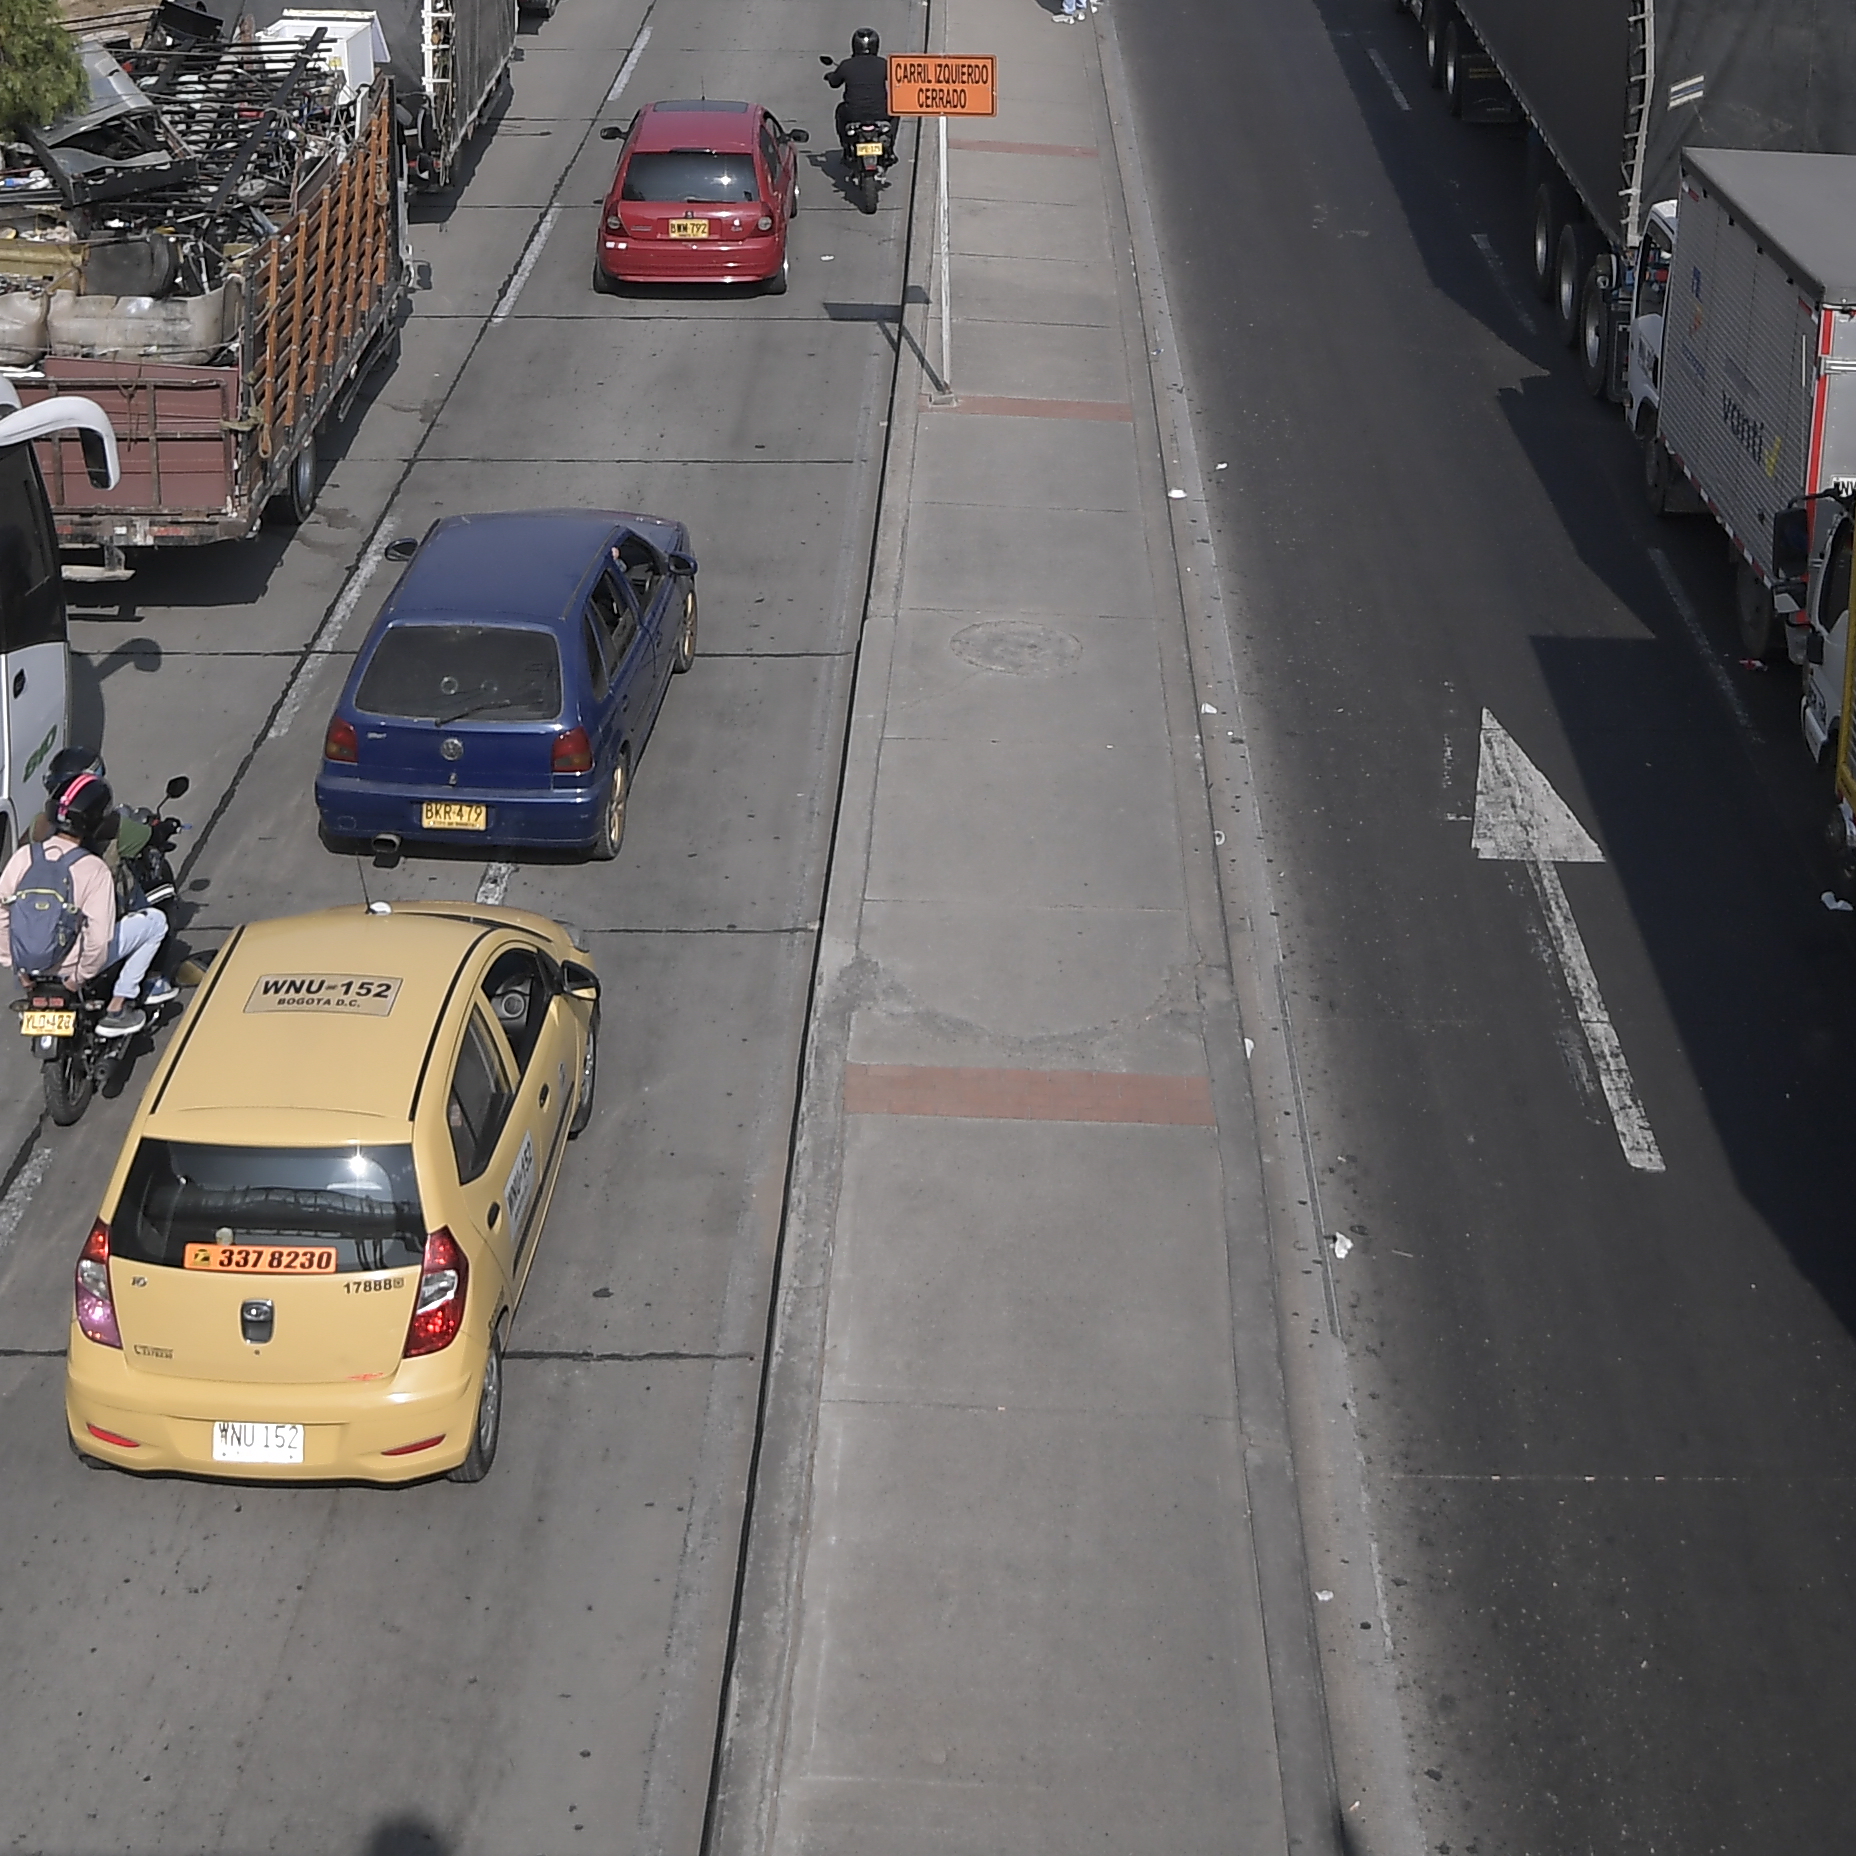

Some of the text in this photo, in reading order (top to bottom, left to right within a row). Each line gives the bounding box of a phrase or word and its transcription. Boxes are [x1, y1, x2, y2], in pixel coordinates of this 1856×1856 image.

[895, 63, 989, 85] CARRIL IZQUIERDO
[917, 88, 967, 109] CERRADO
[276, 997, 332, 1006] BOGOTA
[218, 1249, 334, 1270] 337 8230
[218, 1422, 299, 1449] WNU 152
